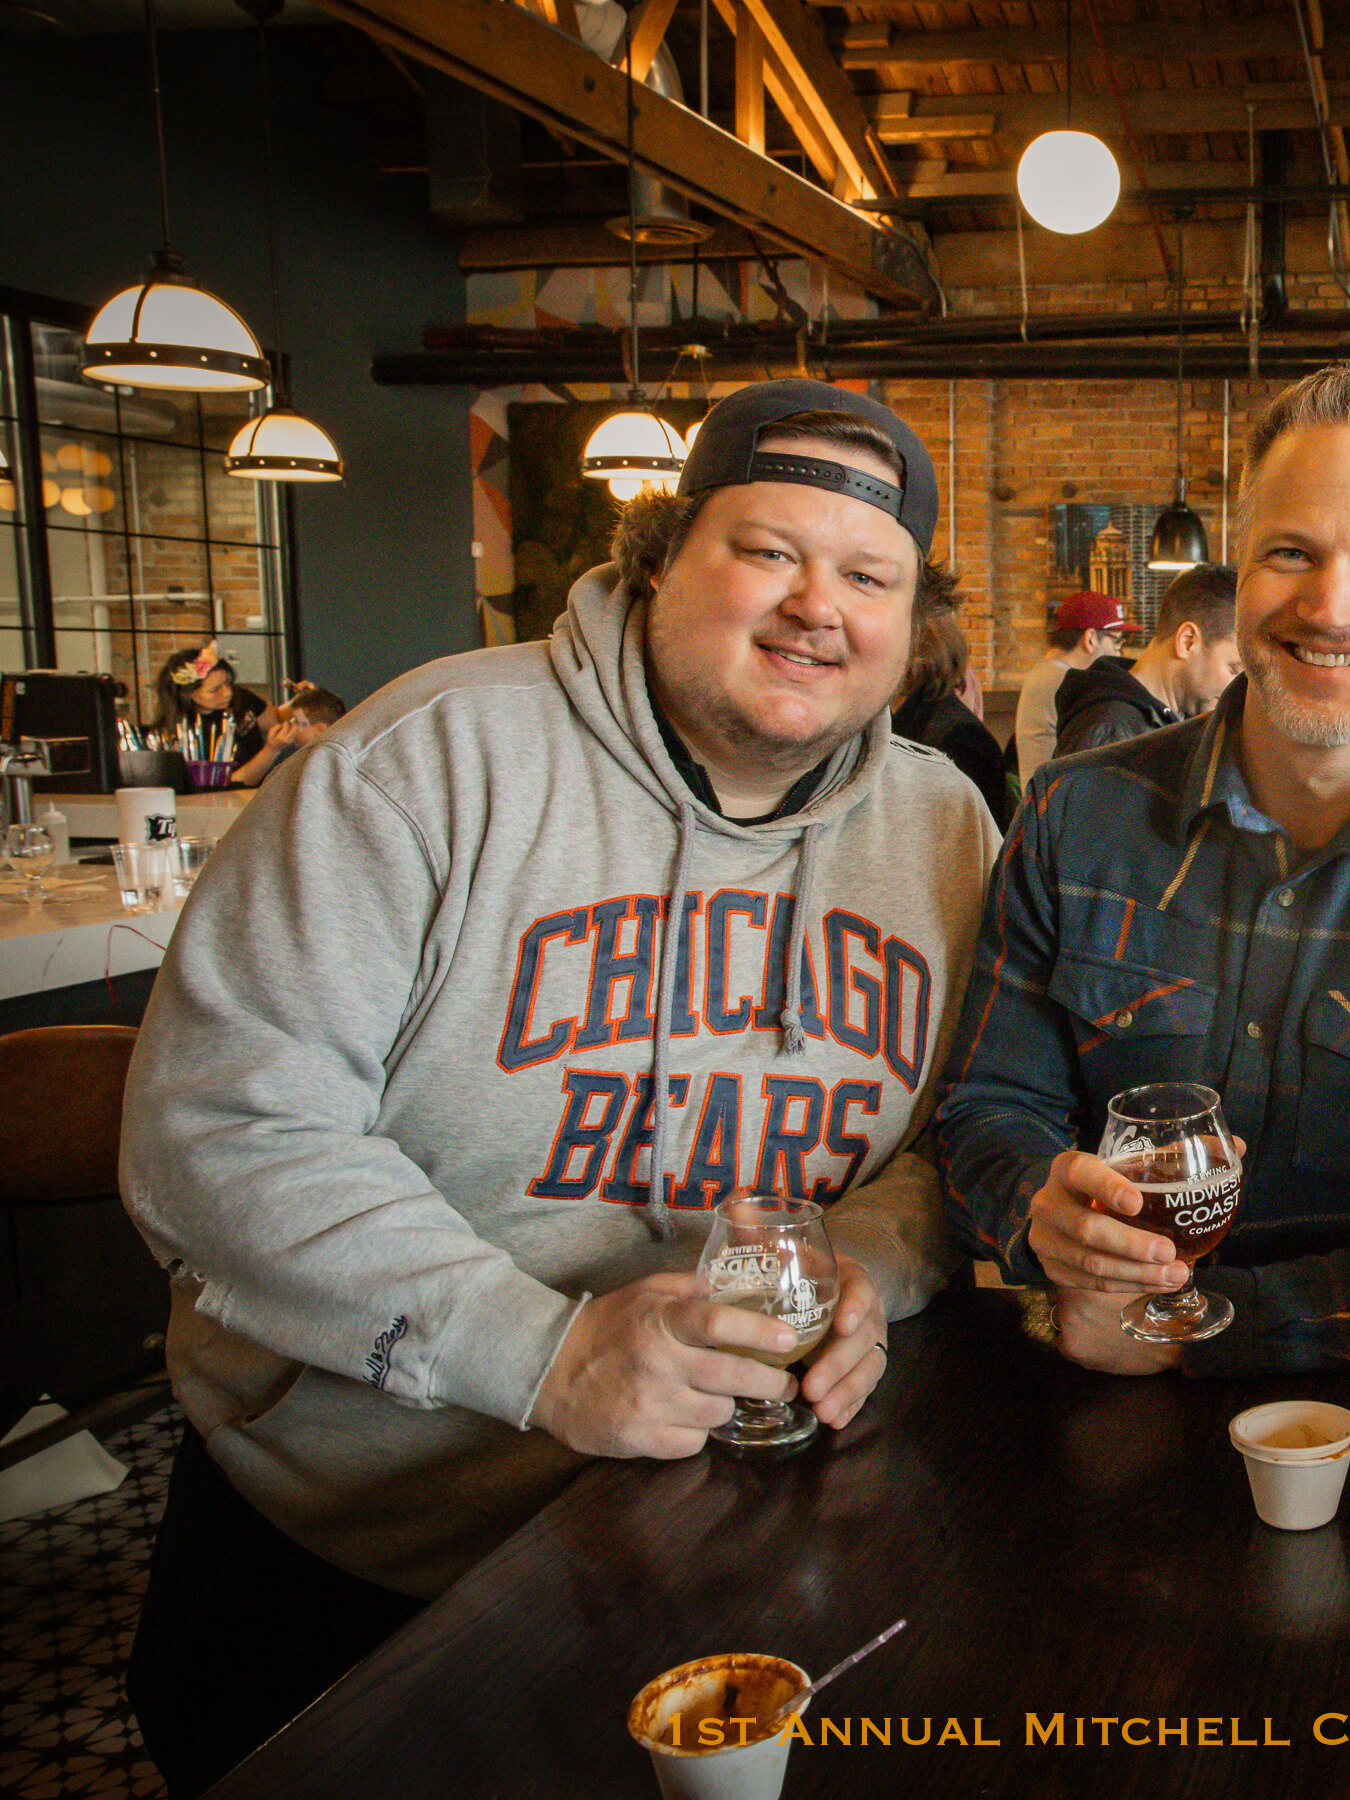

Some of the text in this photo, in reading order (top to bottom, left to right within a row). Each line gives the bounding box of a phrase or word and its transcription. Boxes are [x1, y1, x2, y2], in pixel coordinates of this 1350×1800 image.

[497, 887, 932, 1094] CHICAGO
[525, 1066, 882, 1212] BEARS
[1165, 1168, 1242, 1209] MIDWEST
[1187, 1164, 1228, 1186] BREWING
[1174, 1188, 1241, 1227] COAST
[1188, 1213, 1232, 1236] COMPANY
[777, 1306, 824, 1326] MIDWEST
